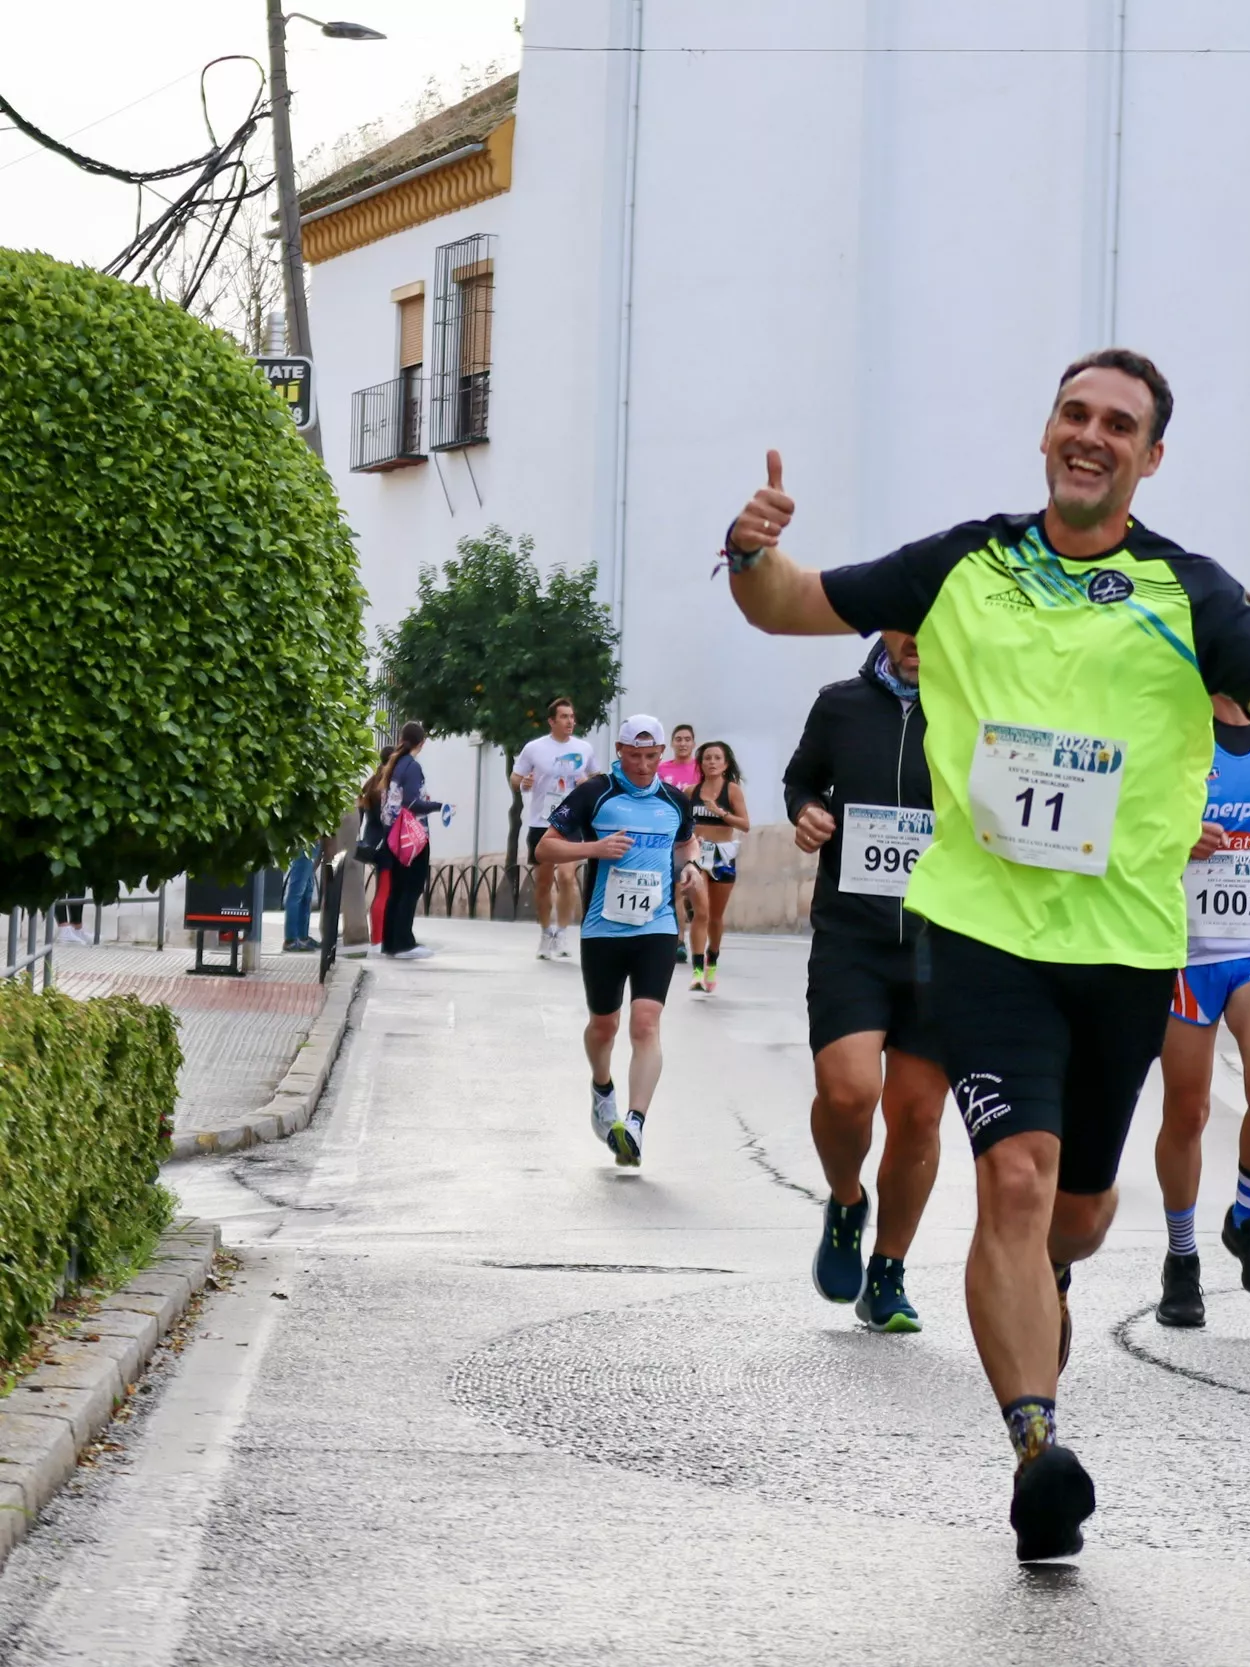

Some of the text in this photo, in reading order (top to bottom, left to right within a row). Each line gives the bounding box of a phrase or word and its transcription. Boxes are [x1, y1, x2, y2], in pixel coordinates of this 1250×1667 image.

[1054, 734, 1094, 751] 2024
[1015, 787, 1064, 832] 11
[864, 845, 920, 874] 996
[616, 893, 651, 912] 114
